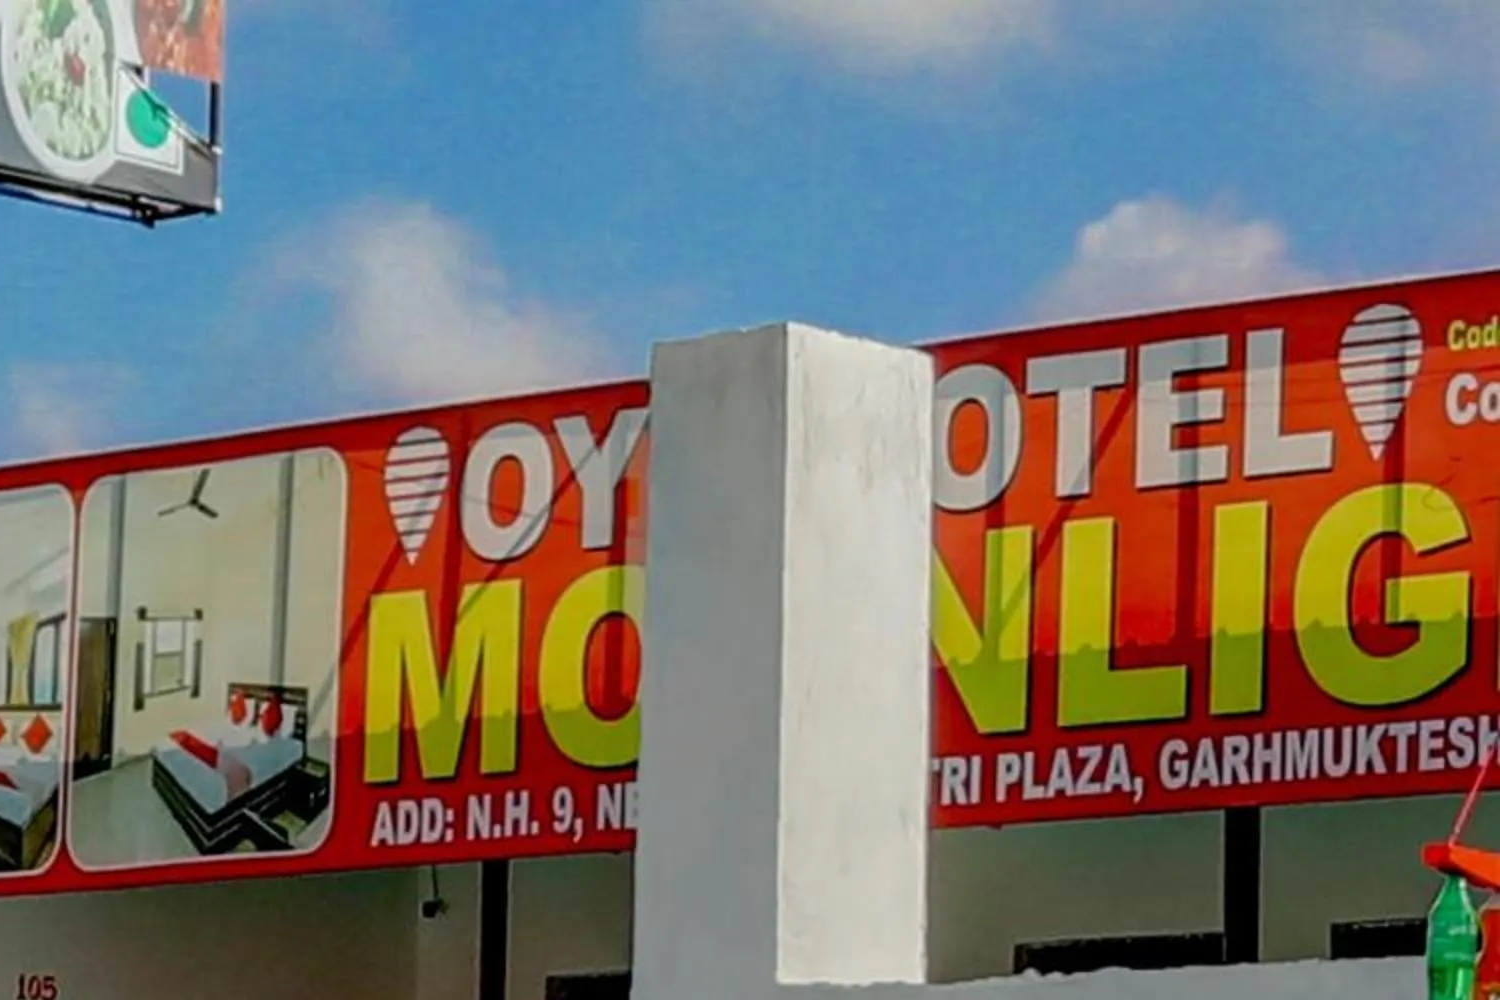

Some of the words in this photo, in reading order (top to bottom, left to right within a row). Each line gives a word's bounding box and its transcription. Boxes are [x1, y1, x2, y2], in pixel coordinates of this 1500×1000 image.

[932, 328, 1334, 512] OTEL
[370, 798, 454, 847] ADD:
[466, 790, 539, 841] N.H.
[552, 786, 584, 842] 9,
[995, 743, 1144, 804] PLAZA,
